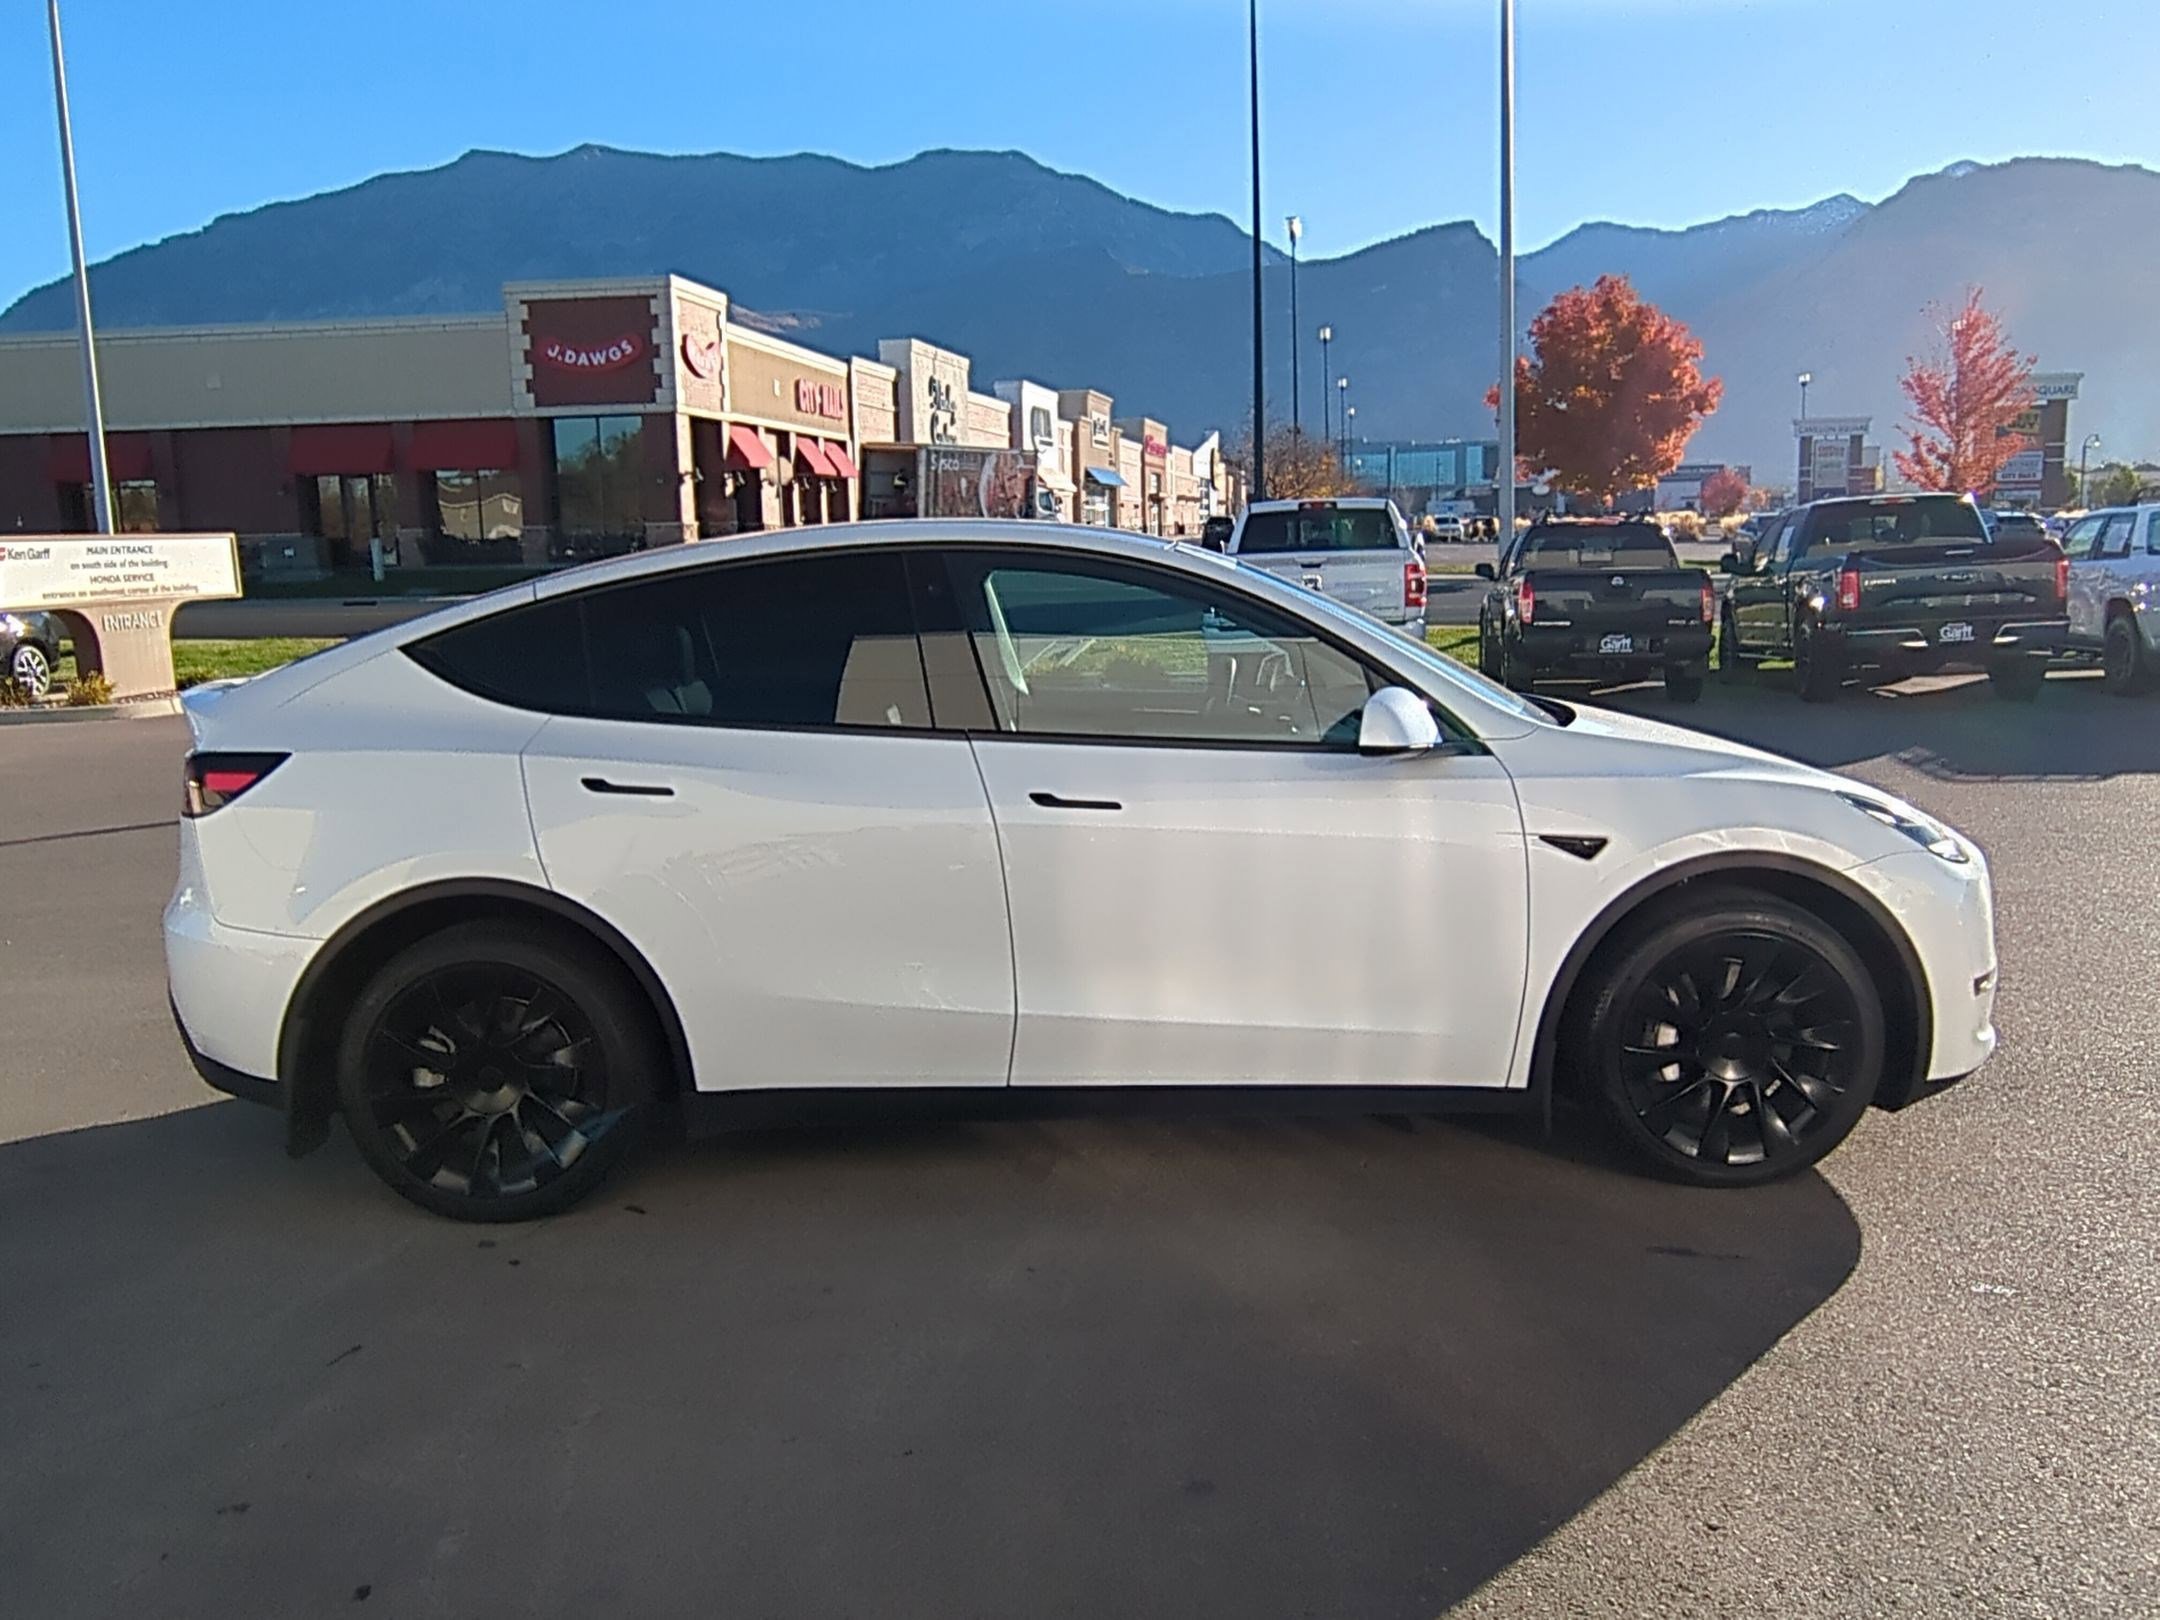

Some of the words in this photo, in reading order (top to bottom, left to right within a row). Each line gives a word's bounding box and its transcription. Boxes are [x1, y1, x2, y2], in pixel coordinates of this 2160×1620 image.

[547, 338, 634, 367] J.DAWGS
[7, 548, 26, 560] Ken
[27, 548, 50, 560] Garff
[86, 546, 108, 555] MAIN
[110, 545, 153, 555] ENTRANCE
[128, 559, 139, 567] the
[90, 574, 121, 584] HONDA
[123, 573, 154, 583] SERVICE
[102, 610, 164, 632] ENTRANCE
